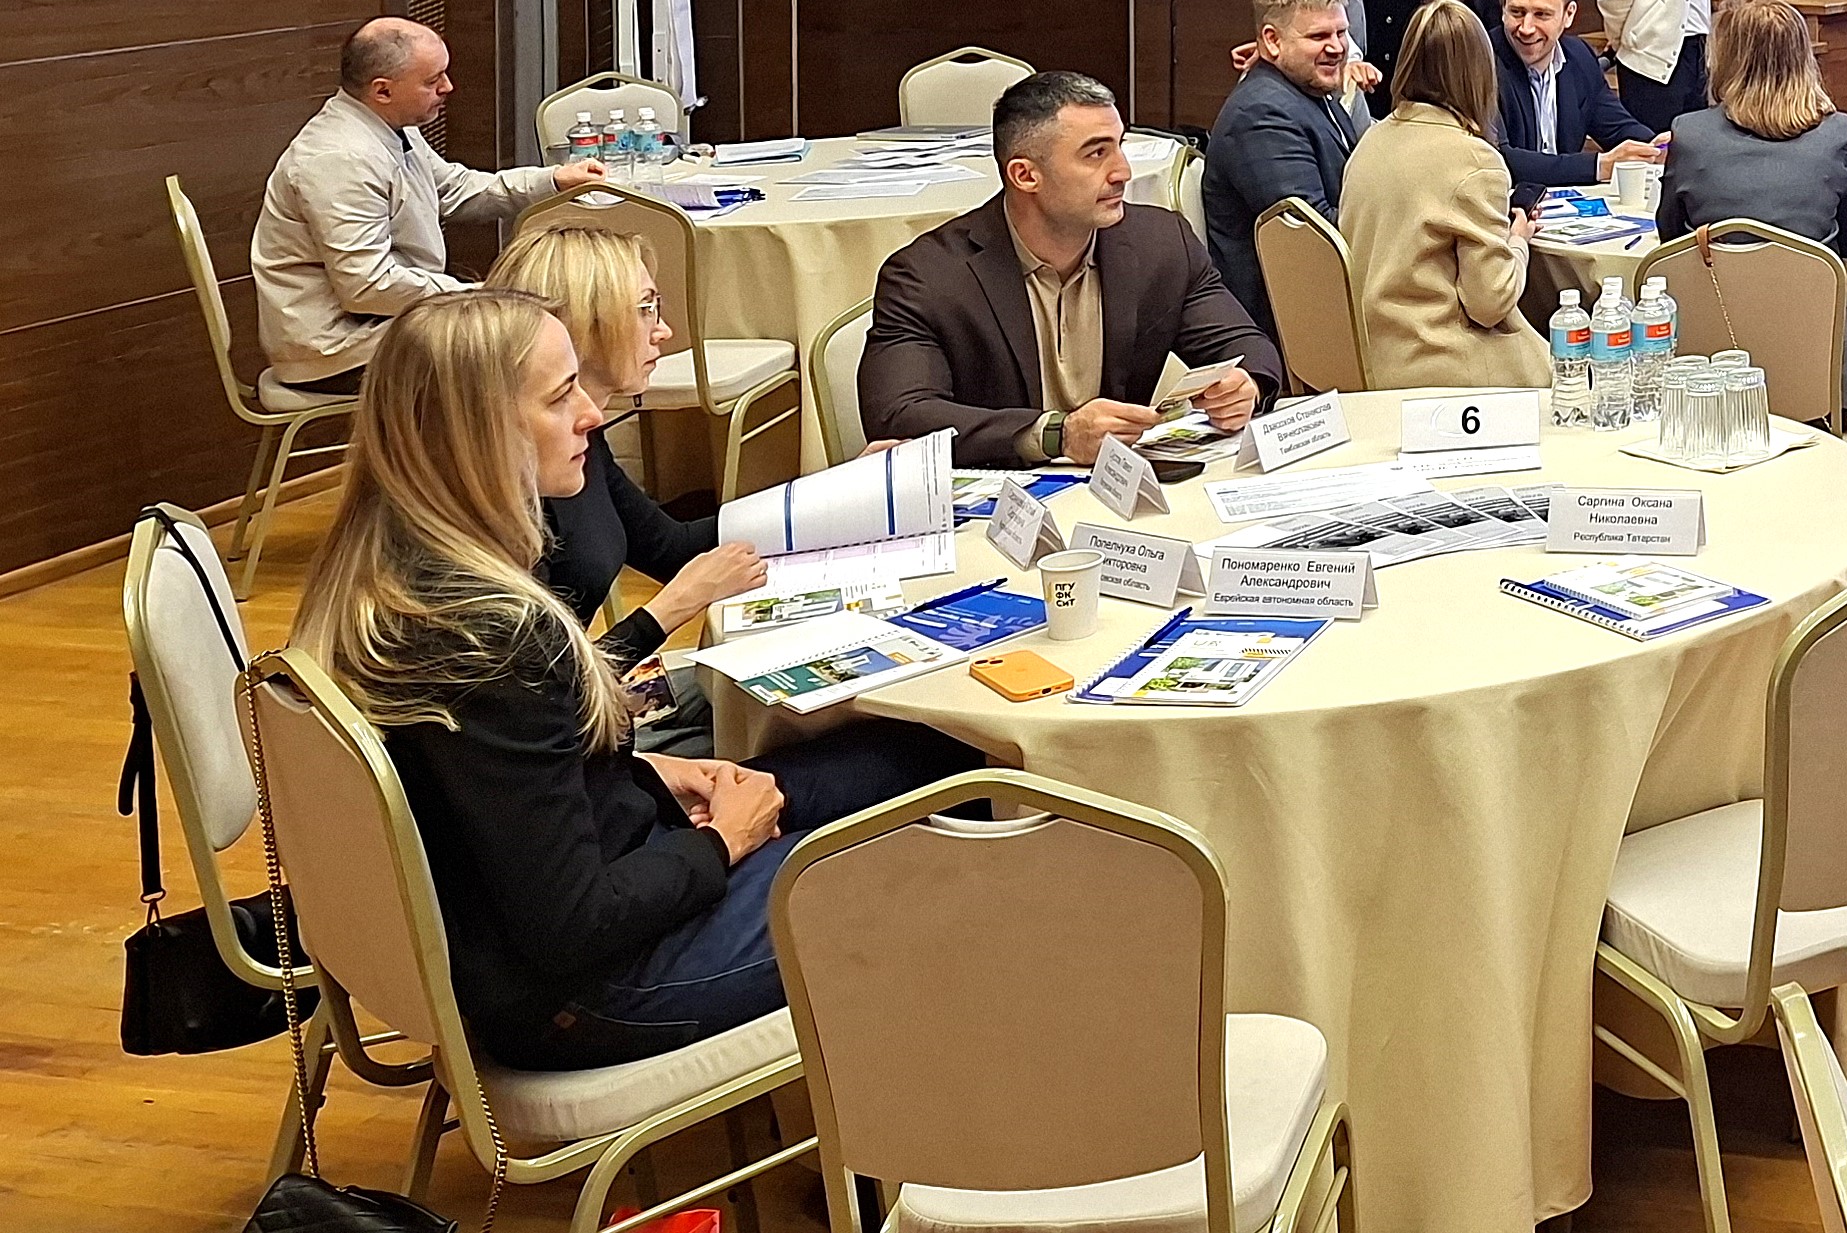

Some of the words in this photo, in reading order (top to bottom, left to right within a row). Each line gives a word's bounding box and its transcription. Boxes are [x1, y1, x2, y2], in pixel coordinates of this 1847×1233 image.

[1461, 405, 1481, 434] 6
[1631, 497, 1673, 508] Оксана
[1589, 513, 1658, 525] Николаевна
[1573, 532, 1624, 543] Республика
[1626, 533, 1671, 544] Татарстан
[1138, 545, 1165, 560] Ольга
[1103, 557, 1147, 573] икторовна
[1221, 558, 1300, 573] Пономаренко
[1307, 560, 1355, 573] Евгений
[1055, 582, 1075, 591] ПГУ
[1240, 575, 1331, 590] Александрович
[1055, 591, 1071, 599] ФК
[1214, 593, 1260, 604] Еврейская
[1262, 595, 1315, 605] автономная
[1317, 596, 1354, 607] область
